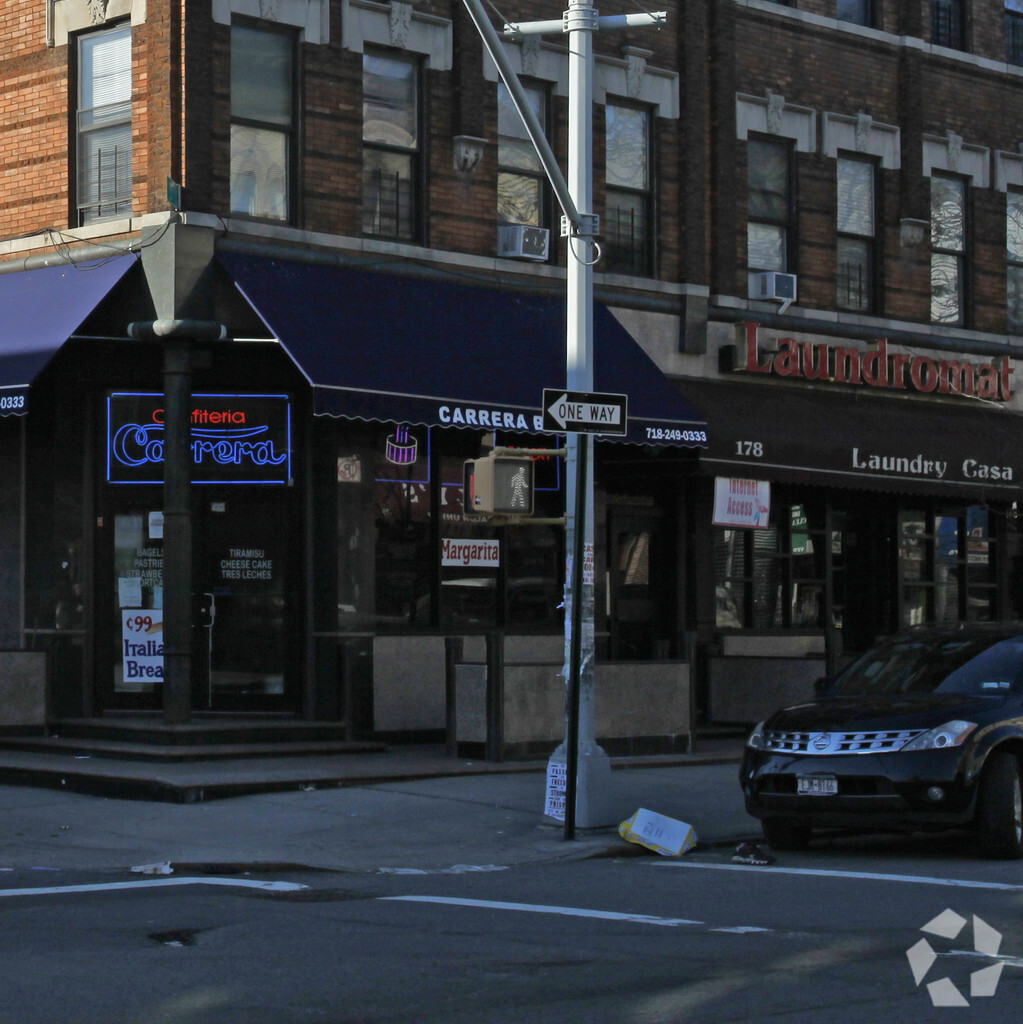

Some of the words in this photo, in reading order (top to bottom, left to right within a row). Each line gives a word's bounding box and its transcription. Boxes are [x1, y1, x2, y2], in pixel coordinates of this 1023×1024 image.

[742, 321, 1015, 402] Laundromat
[152, 409, 245, 423] Cfiteria
[438, 405, 529, 430] CARRERA
[559, 404, 583, 420] ONE
[590, 406, 615, 422] WAY
[645, 427, 707, 442] 718-249-0333
[113, 424, 287, 466] Carera
[735, 440, 763, 457] 178
[852, 447, 947, 478] Laundry
[962, 458, 1013, 480] Casa
[729, 478, 758, 496] Internet
[727, 497, 753, 516] Access
[229, 548, 265, 558] TIRAMISU
[441, 539, 498, 565] Margarita
[134, 558, 164, 568] PASTRIE
[220, 559, 250, 569] CHEESE
[251, 560, 273, 569] CAKE
[126, 569, 163, 578] STRAWBE
[141, 578, 163, 587] ORTCA
[222, 570, 241, 579] TRES
[242, 570, 272, 580] LECHES
[124, 639, 164, 657] Italia
[127, 660, 164, 678] Brea
